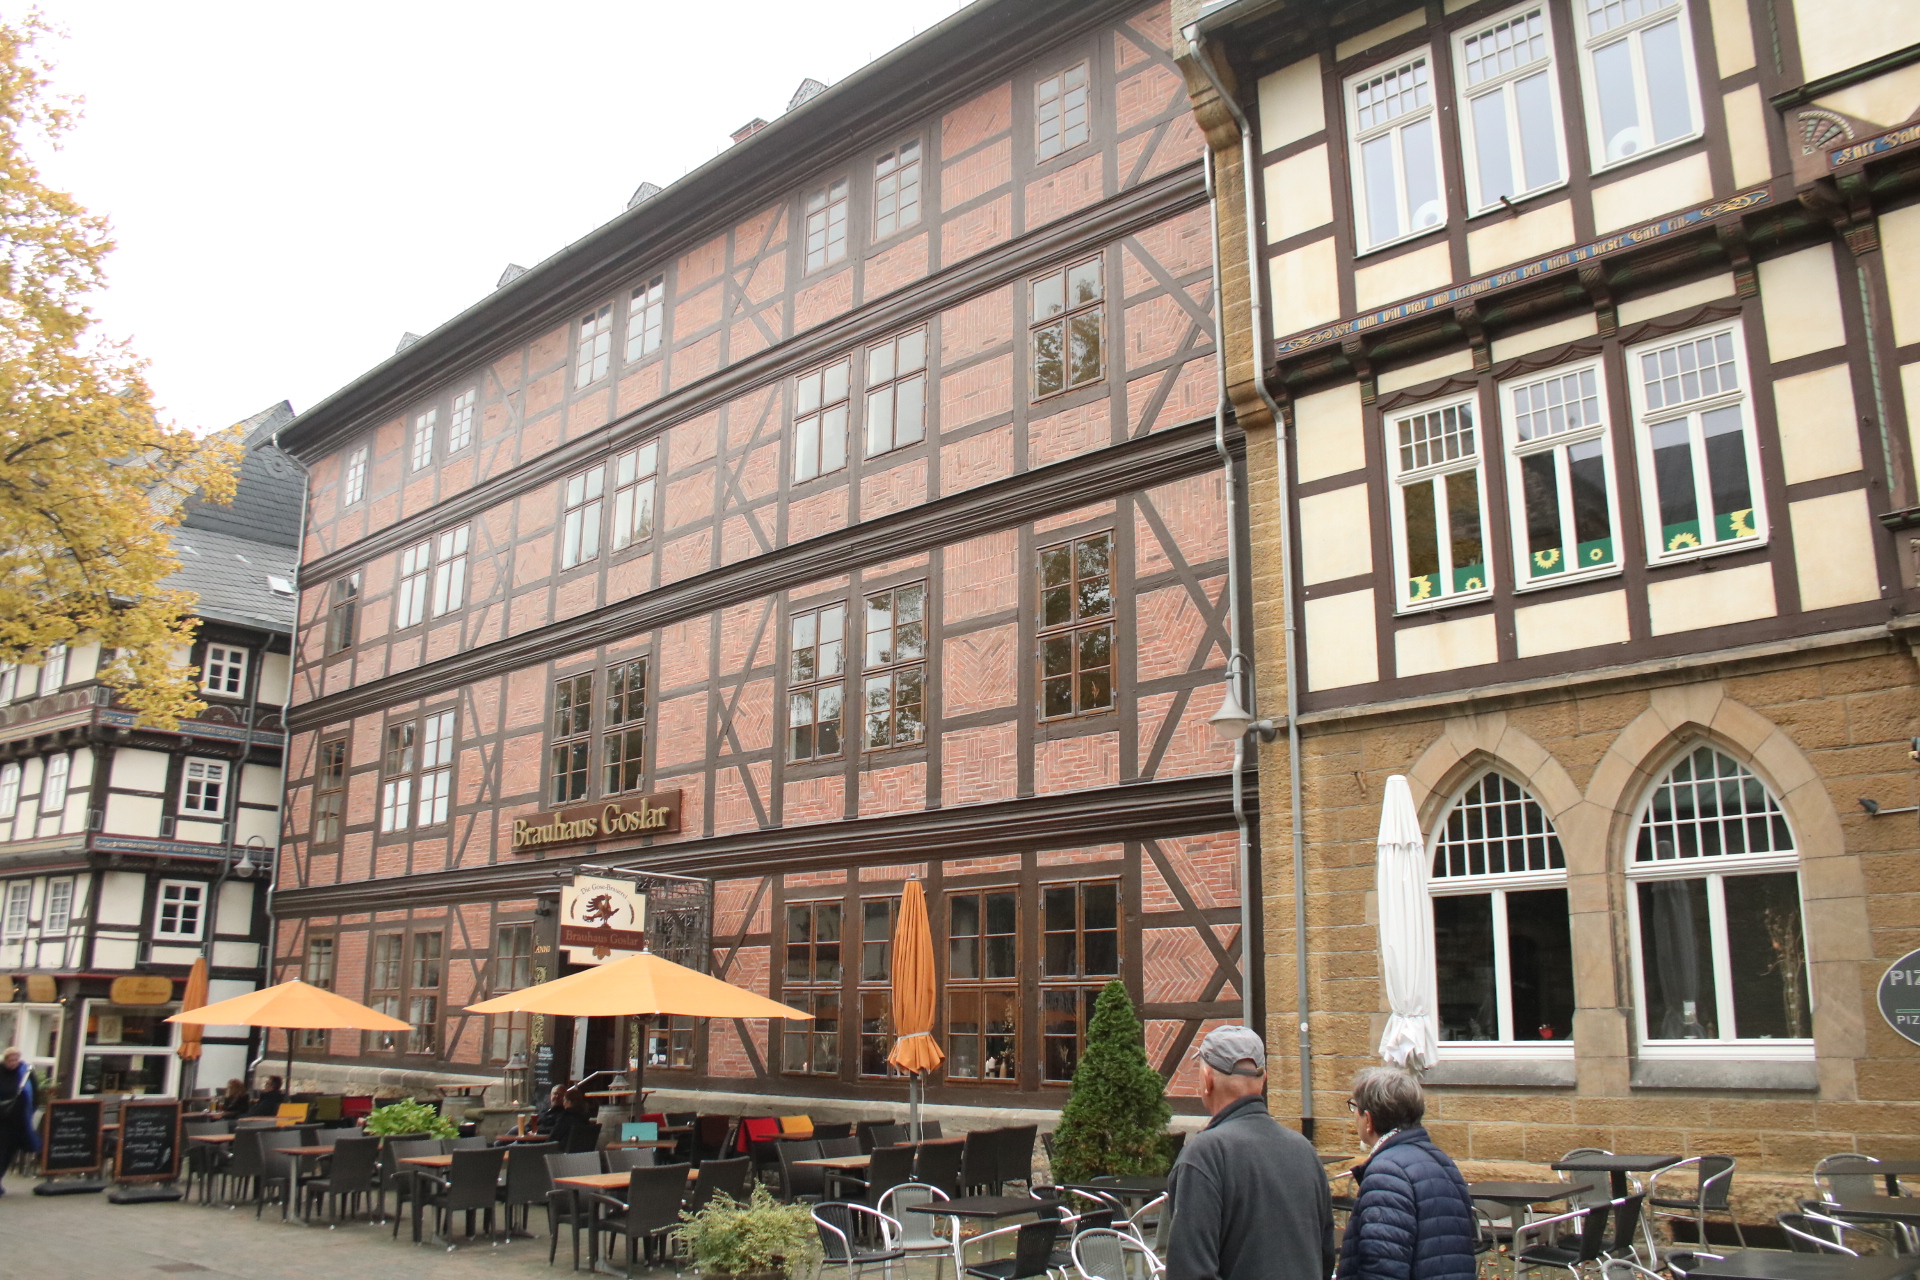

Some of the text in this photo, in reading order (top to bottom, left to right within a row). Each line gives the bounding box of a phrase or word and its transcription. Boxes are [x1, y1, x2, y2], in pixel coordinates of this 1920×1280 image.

[1383, 308, 1401, 323] will
[512, 797, 670, 847] Brauhaus Goslar
[580, 883, 629, 900] Die Gose-Brauerei
[565, 929, 639, 946] Brauhaus Goslar
